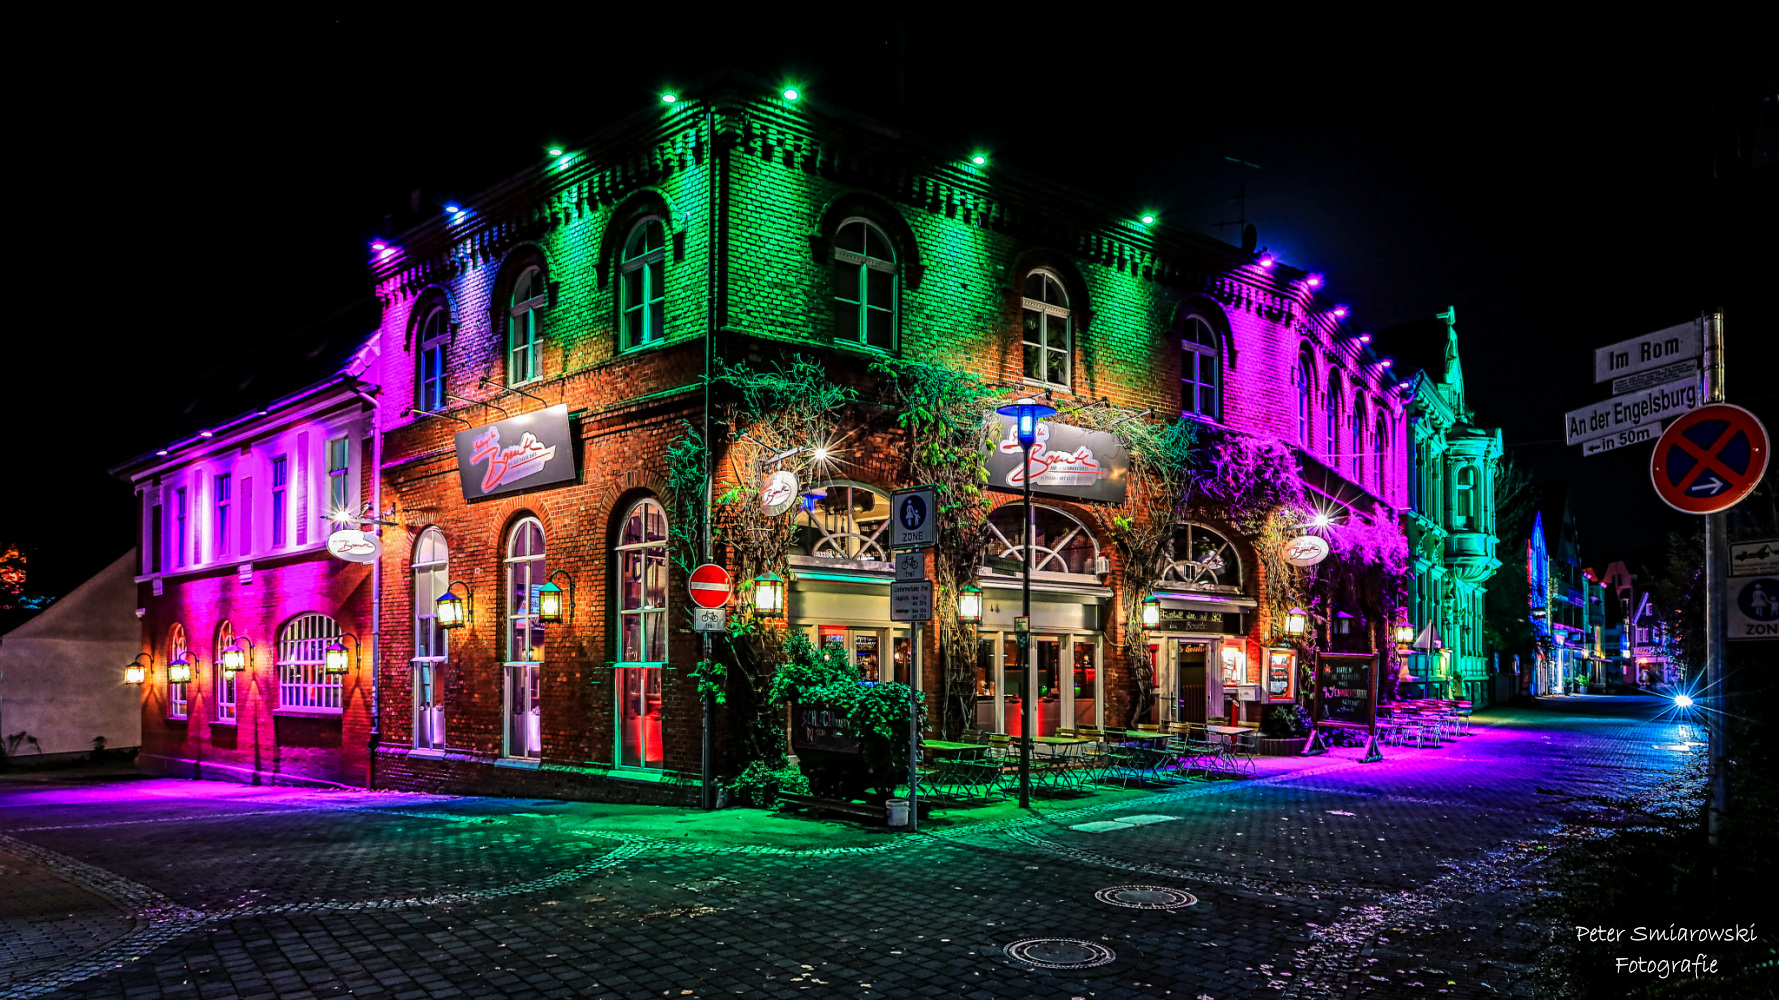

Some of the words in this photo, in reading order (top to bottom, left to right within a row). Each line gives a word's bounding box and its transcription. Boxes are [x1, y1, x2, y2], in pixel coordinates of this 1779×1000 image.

[1609, 351, 1629, 371] Im
[1640, 338, 1679, 362] Rom
[1570, 417, 1587, 438] An
[1590, 410, 1610, 431] der
[1614, 385, 1696, 425] Engelsburg
[1602, 438, 1615, 451] in
[1619, 428, 1650, 446] 50m
[902, 531, 924, 542] ZONE
[1746, 624, 1779, 635] ZON
